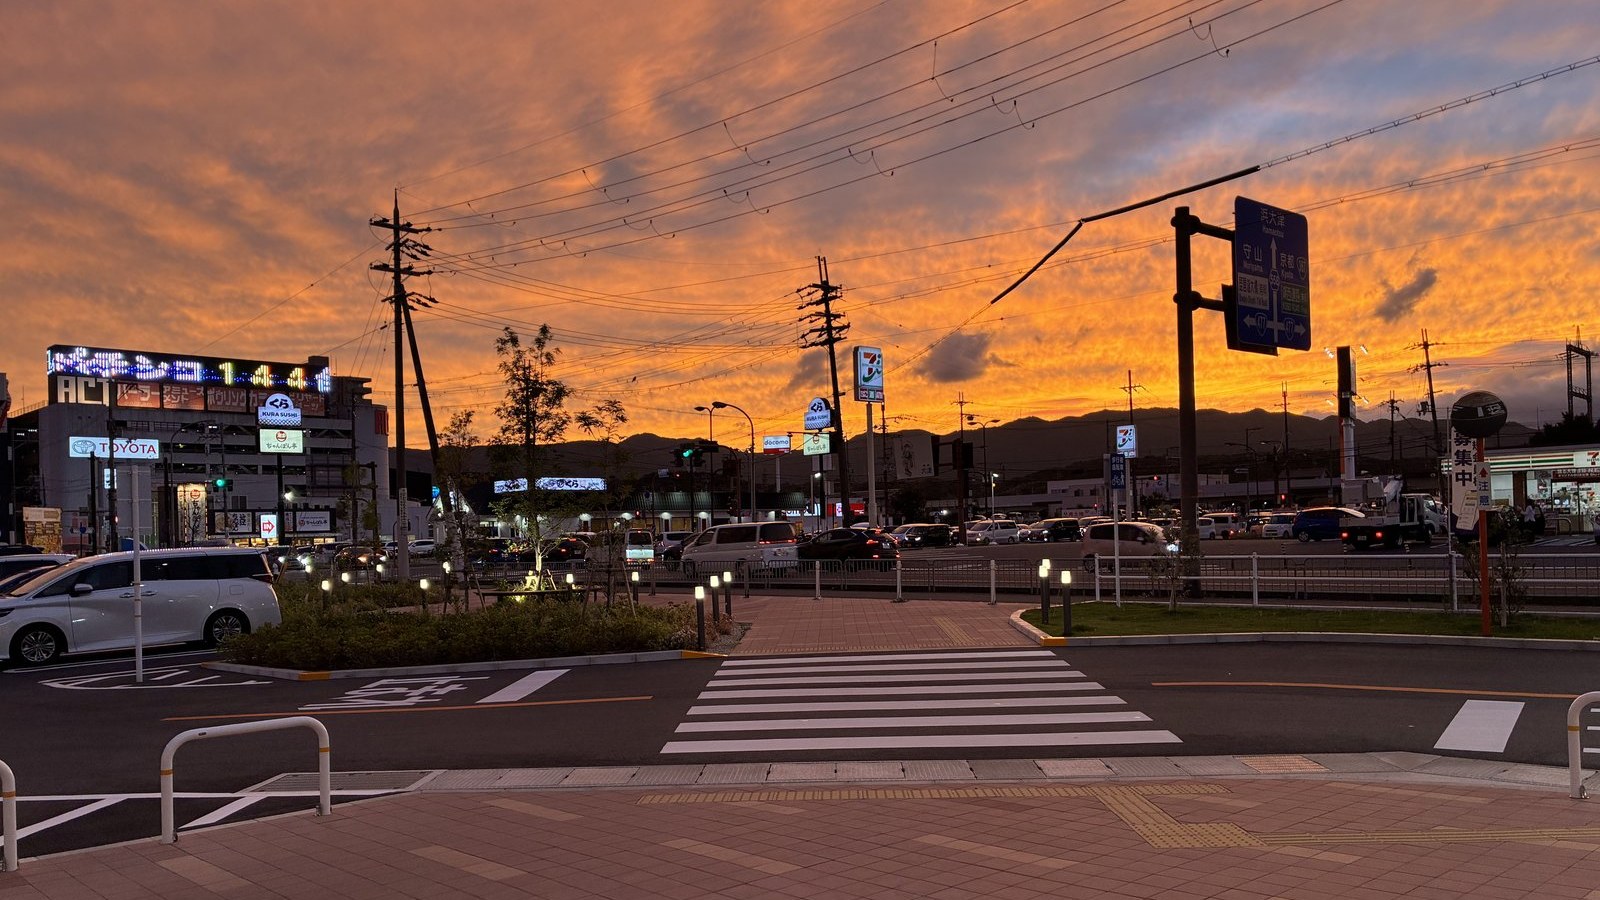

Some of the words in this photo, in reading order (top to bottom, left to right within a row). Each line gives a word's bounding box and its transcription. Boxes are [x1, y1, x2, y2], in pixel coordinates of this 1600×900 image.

[1243, 244, 1262, 262] 守山
[1280, 253, 1295, 270] 京都
[57, 376, 110, 406] ACT
[117, 383, 160, 402] パーラー
[163, 394, 189, 404] メント
[269, 398, 289, 409] くら
[811, 401, 824, 413] くら
[99, 442, 157, 454] TOYOTA
[1478, 480, 1490, 506] 注意
